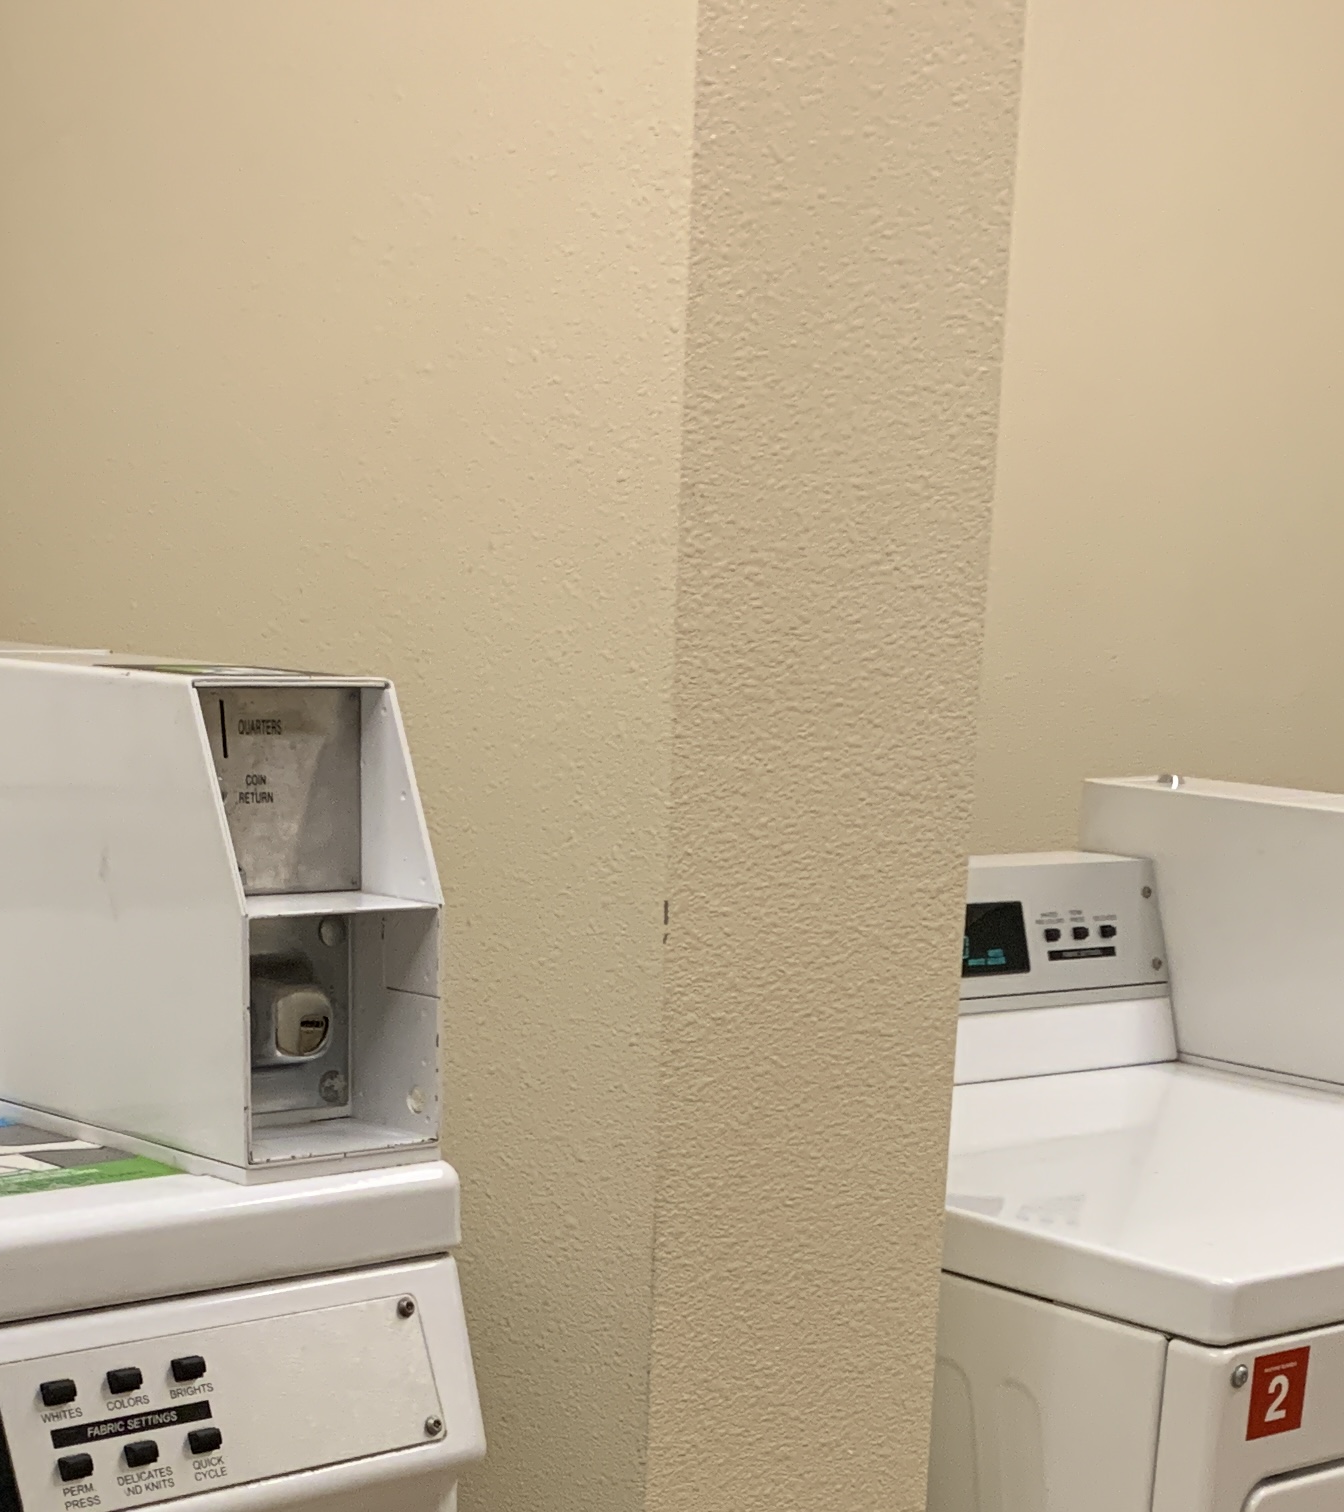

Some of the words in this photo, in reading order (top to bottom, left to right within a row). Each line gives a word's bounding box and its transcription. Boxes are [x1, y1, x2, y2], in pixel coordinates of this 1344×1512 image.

[238, 719, 282, 735] QUARTERS
[246, 774, 266, 786] COIN
[238, 791, 274, 804] RETURN
[169, 1382, 214, 1399] BRIGHTS
[1264, 1374, 1289, 1422] 2
[106, 1395, 150, 1411] COLORS
[41, 1407, 83, 1424] WHITES
[87, 1418, 124, 1438] FABRIC
[127, 1411, 178, 1430] SETTINGS
[193, 1456, 224, 1472] QUICK
[117, 1466, 173, 1486] DELICATES
[194, 1467, 227, 1482] CYCLE
[145, 1478, 175, 1492] KNITS
[65, 1496, 101, 1511] PRESS
